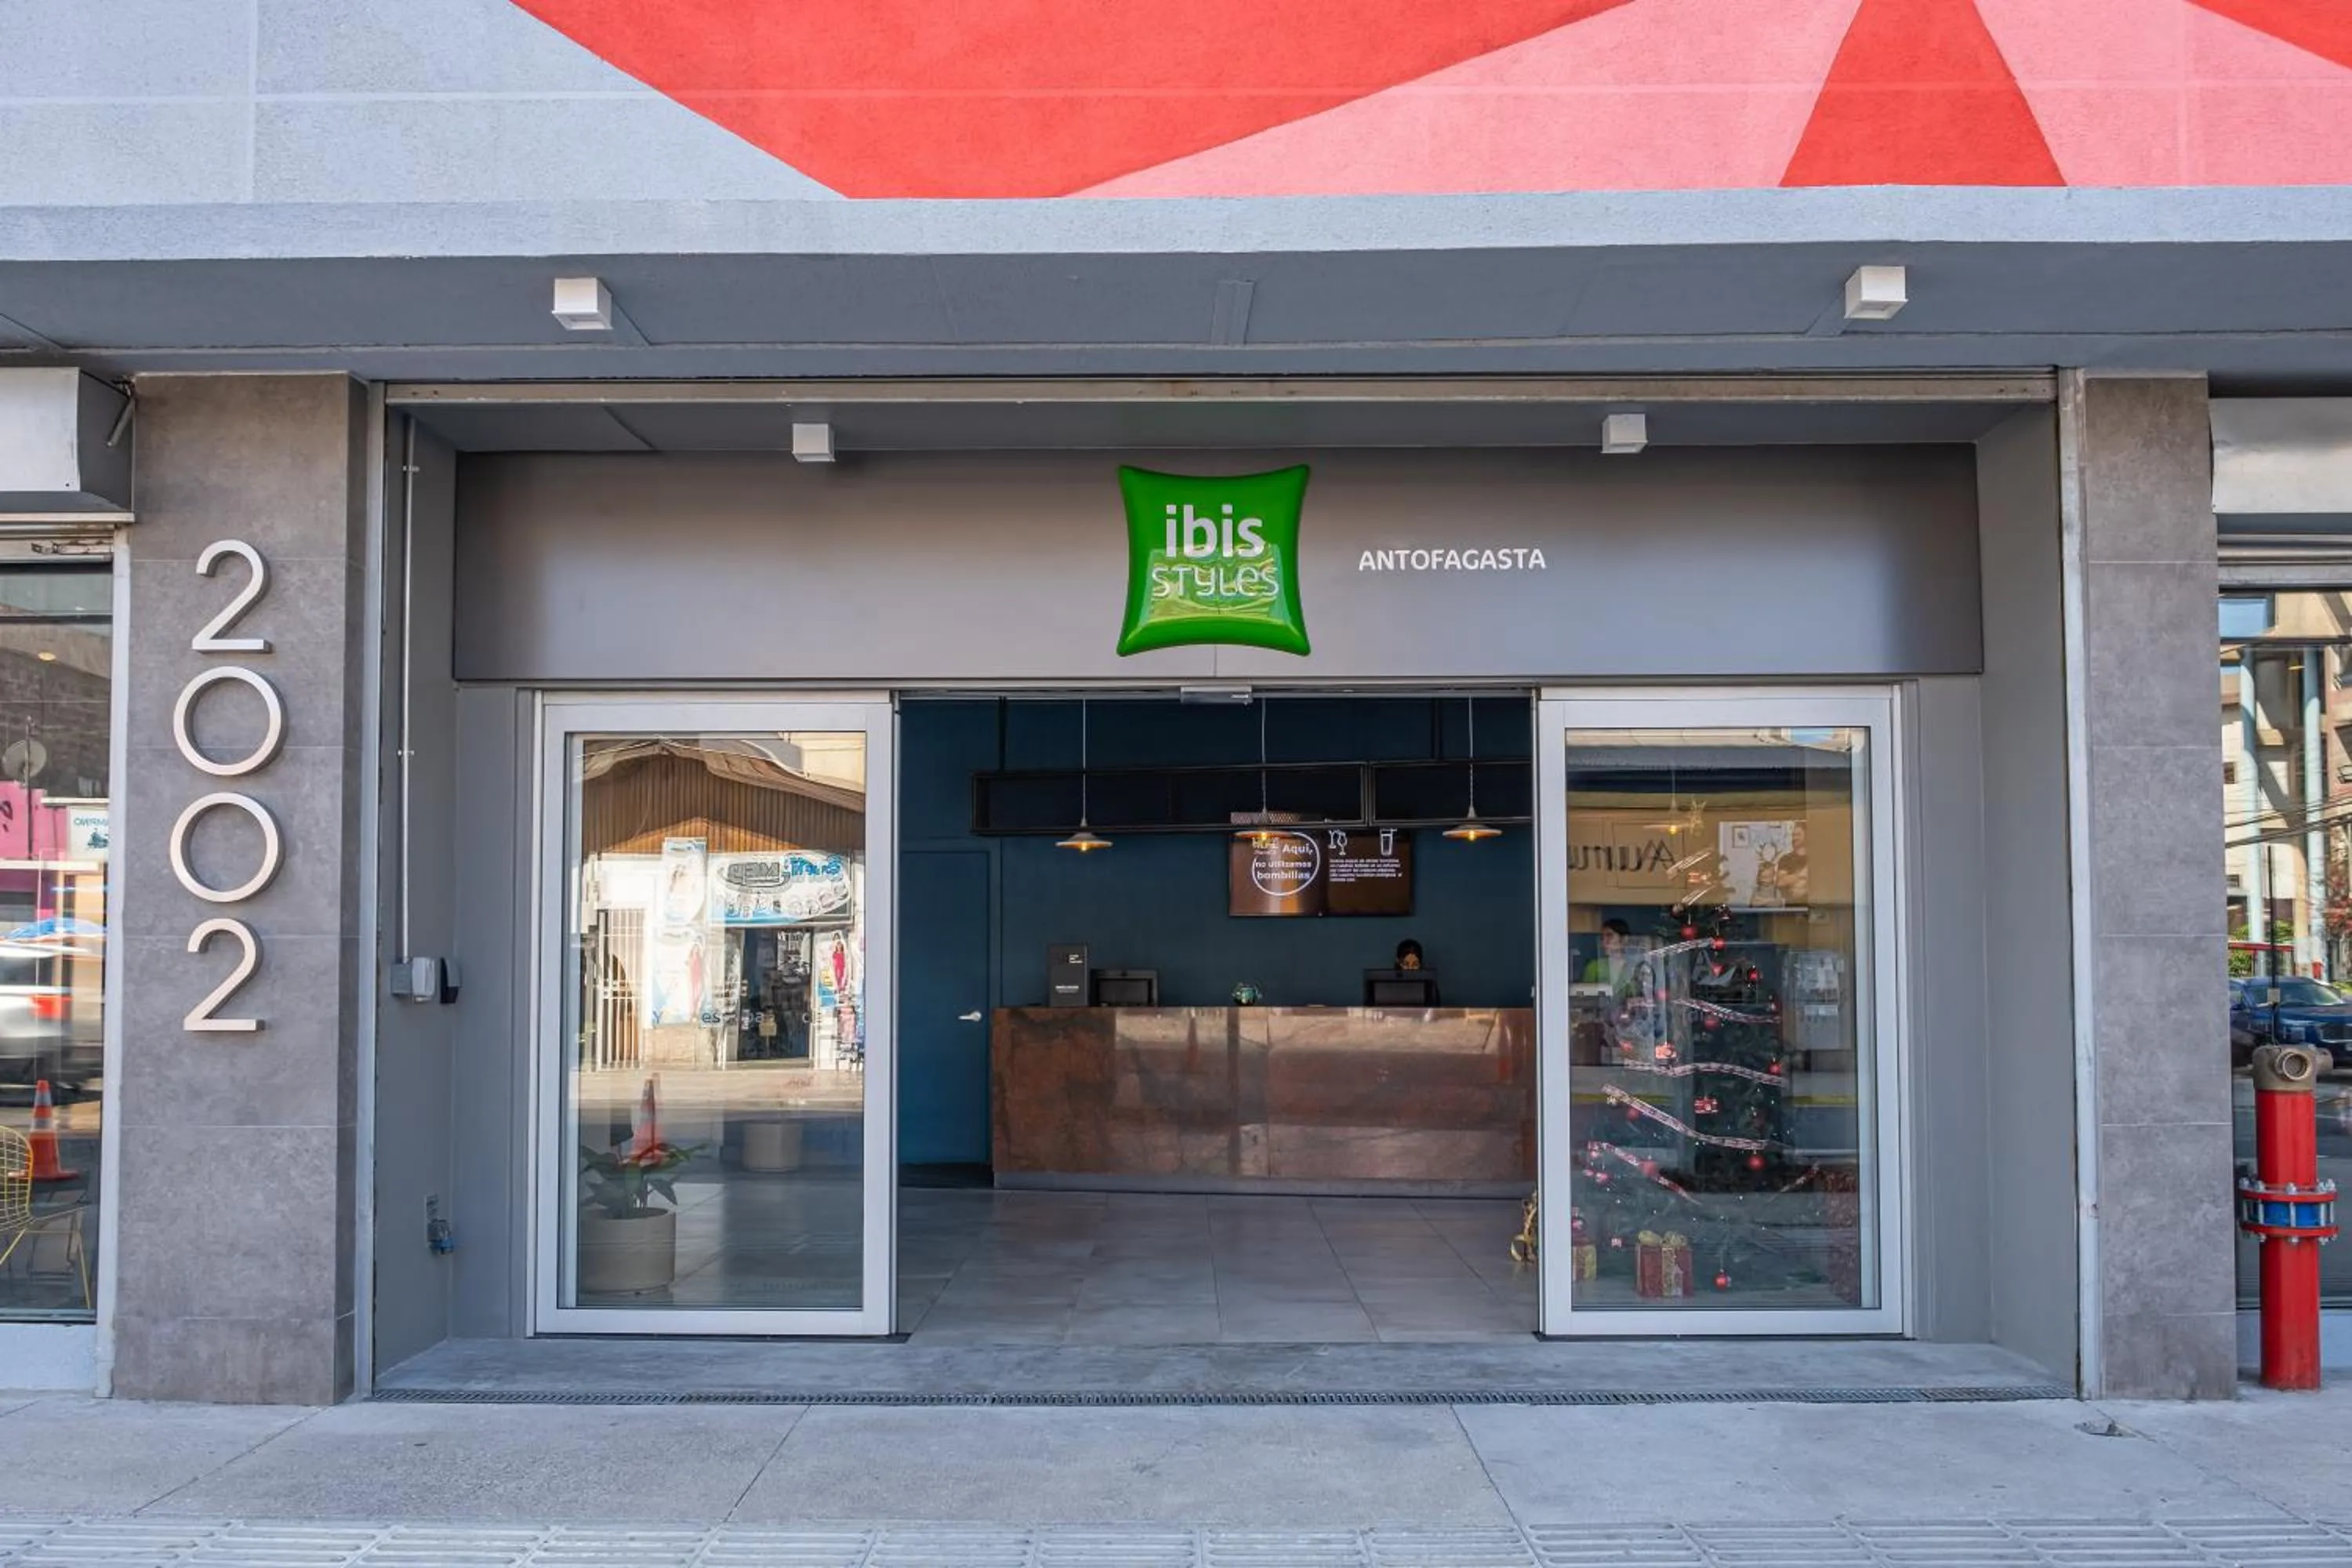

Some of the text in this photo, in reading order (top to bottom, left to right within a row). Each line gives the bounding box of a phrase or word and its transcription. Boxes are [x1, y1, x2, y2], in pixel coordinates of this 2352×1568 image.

[1165, 503, 1265, 558] ibis
[1358, 548, 1547, 572] ANTOFAGASTA
[169, 539, 284, 1031] 2002
[1257, 870, 1311, 879] bombillas
